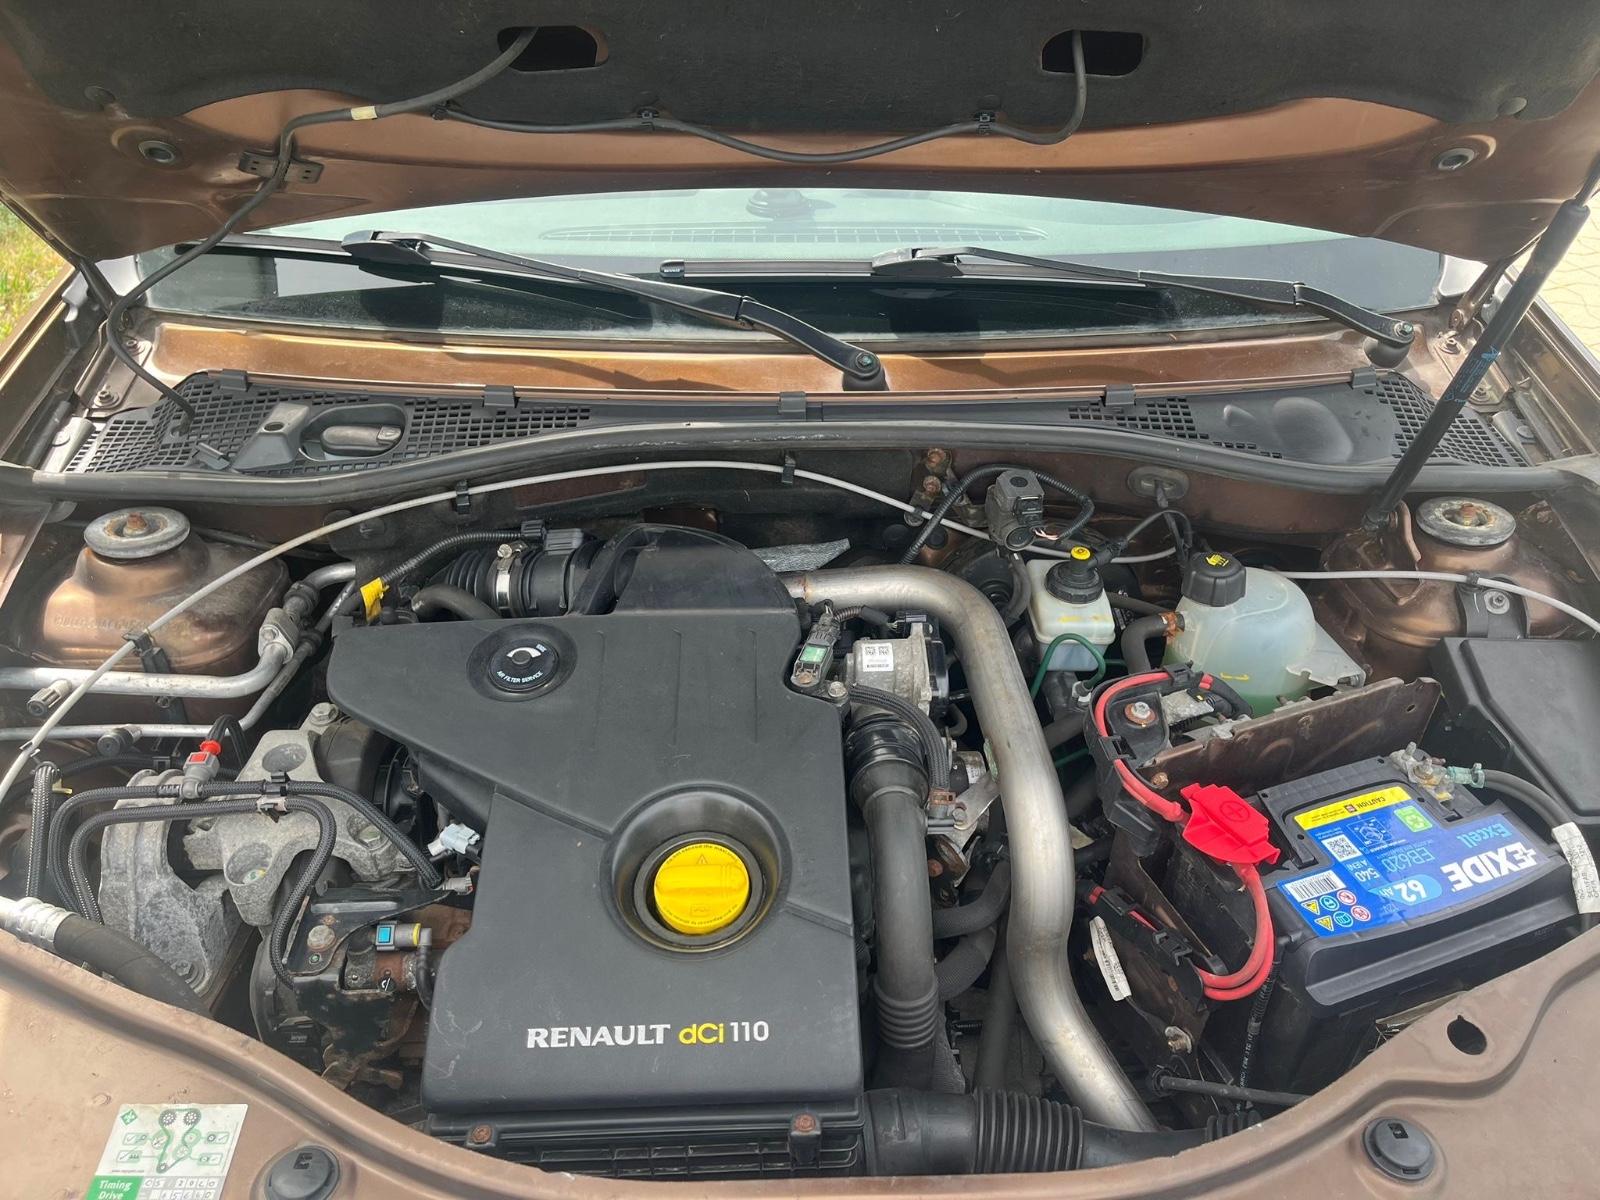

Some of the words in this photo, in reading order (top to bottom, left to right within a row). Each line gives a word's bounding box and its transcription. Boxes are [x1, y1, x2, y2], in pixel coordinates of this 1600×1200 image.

[503, 675, 521, 683] FILTER
[1356, 796, 1387, 809] CAUTION
[1456, 823, 1514, 849] Excell
[1381, 846, 1436, 873] EB620
[1440, 842, 1538, 893] EXIDE
[1354, 867, 1381, 883] 540
[1378, 886, 1395, 898] Ah
[1393, 879, 1428, 903] 62
[526, 1024, 672, 1049] RENAULT
[678, 1023, 725, 1045] dCi
[730, 1020, 770, 1042] 110
[99, 1179, 134, 1192] Timing
[97, 1191, 124, 1200] Drive
